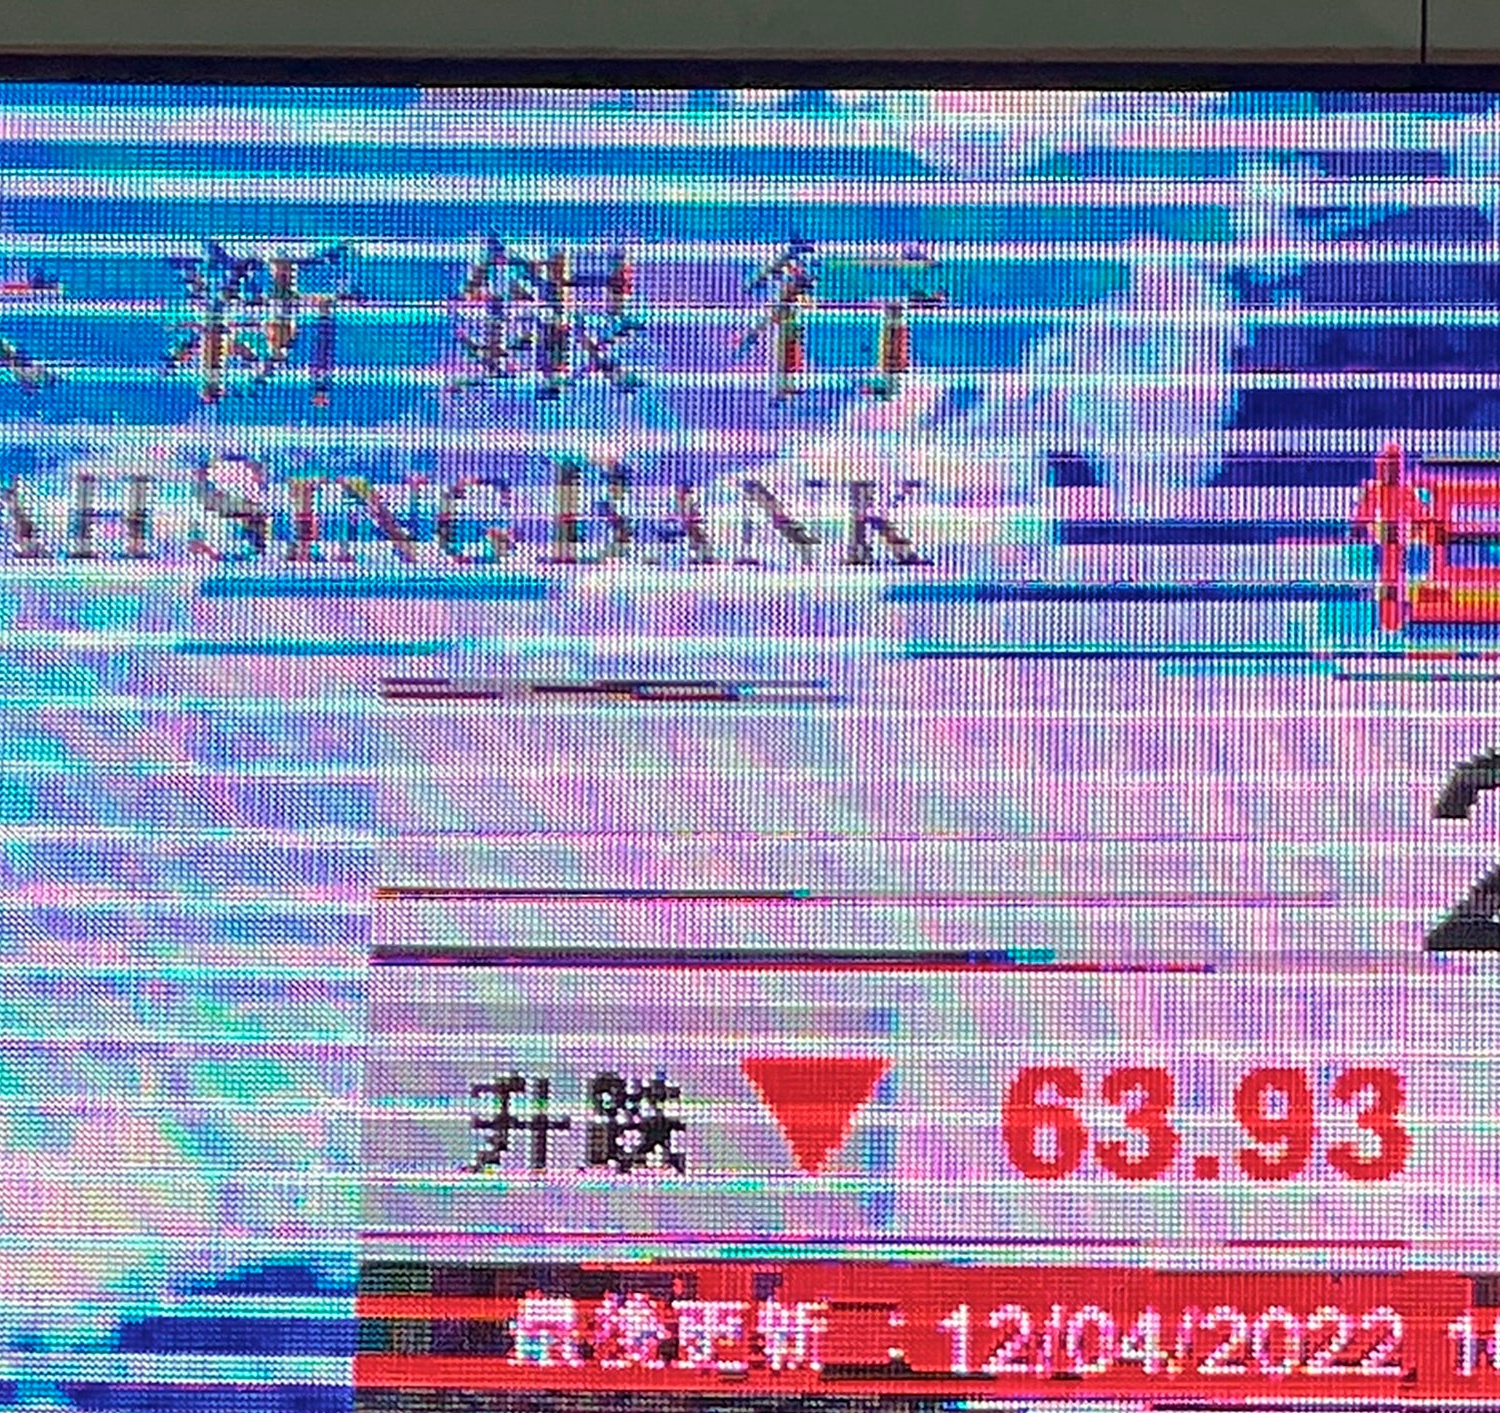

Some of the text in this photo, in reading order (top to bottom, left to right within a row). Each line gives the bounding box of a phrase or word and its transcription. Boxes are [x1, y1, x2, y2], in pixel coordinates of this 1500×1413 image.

[194, 453, 517, 566] SING
[536, 456, 934, 566] BANK
[469, 1076, 688, 1175] 升跌
[1001, 1065, 1409, 1182] 63.93
[941, 1303, 1405, 1377] 12/04/2022
